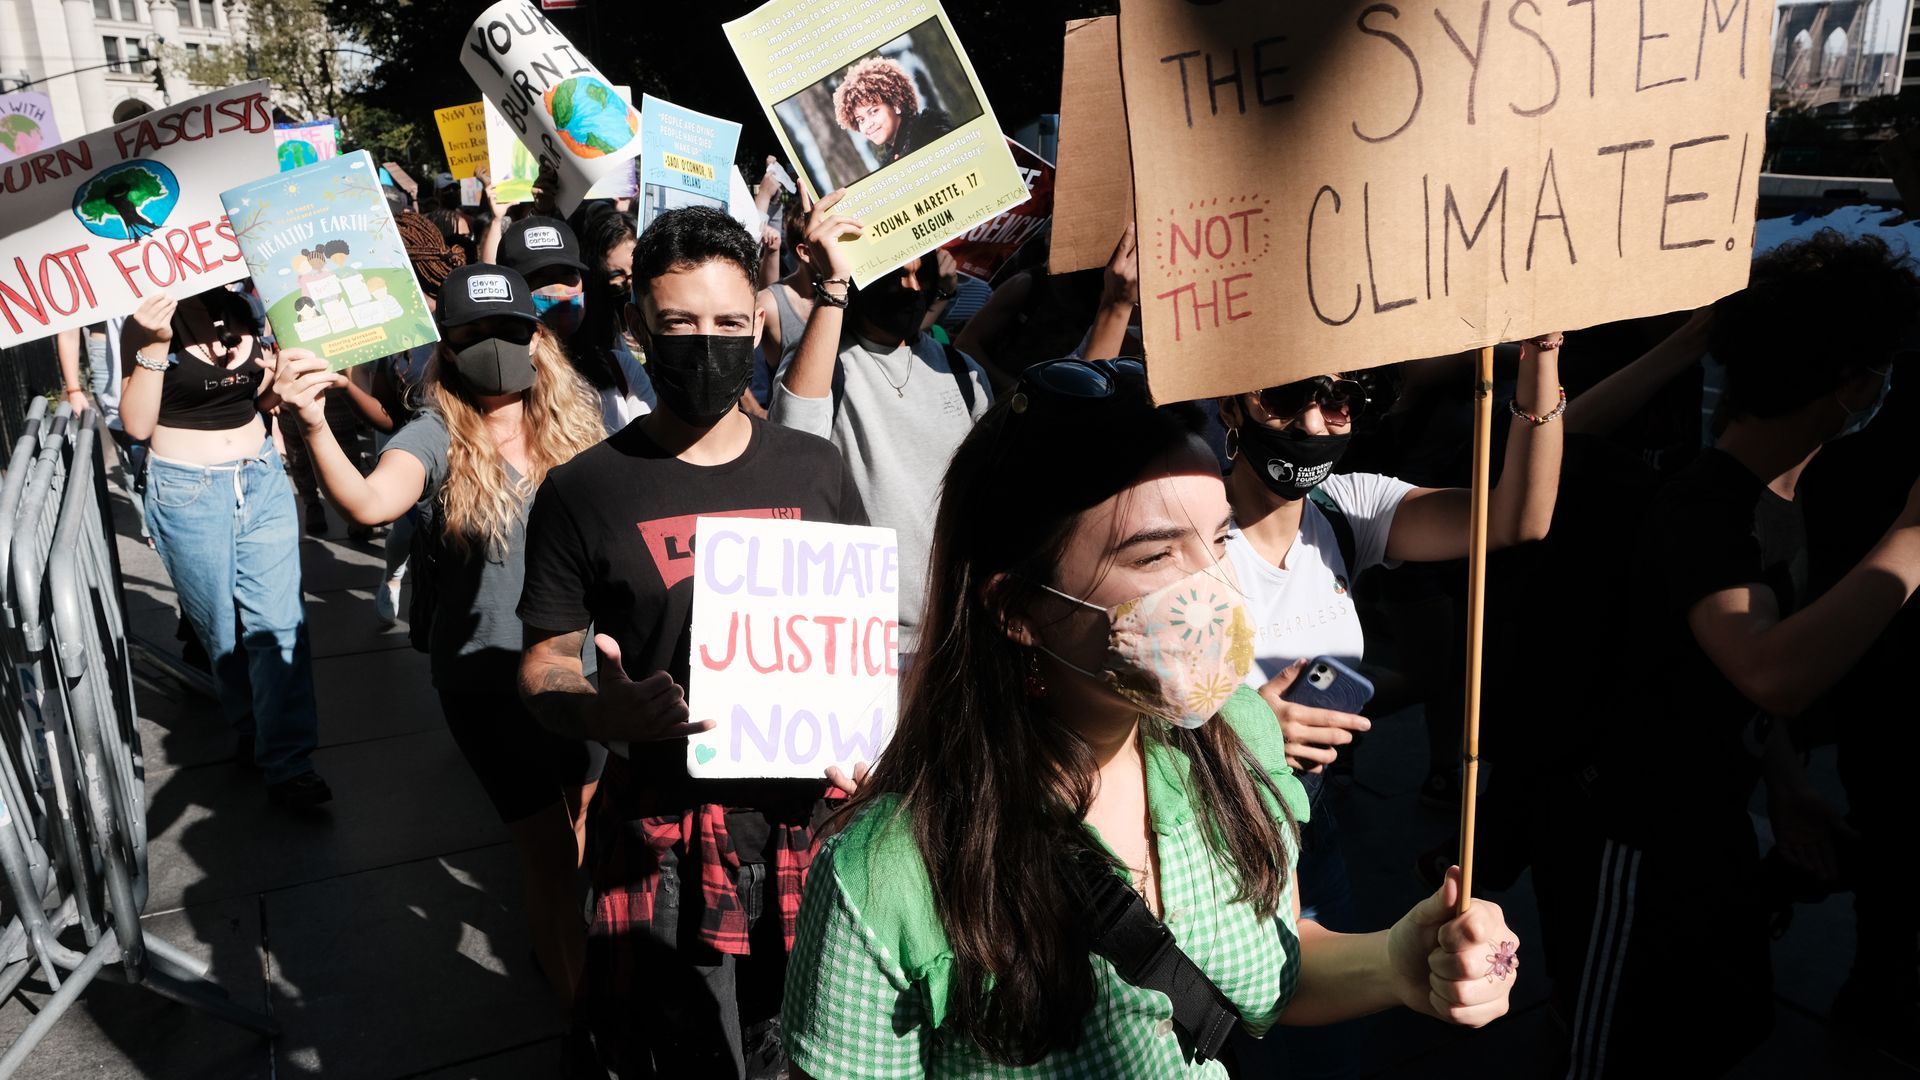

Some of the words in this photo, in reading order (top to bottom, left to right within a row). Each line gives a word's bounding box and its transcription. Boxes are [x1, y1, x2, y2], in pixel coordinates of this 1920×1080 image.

[751, 25, 770, 38] want
[771, 17, 781, 27] to
[783, 9, 797, 22] say
[767, 17, 809, 46] impossible
[809, 12, 820, 22] to
[820, 1, 840, 18] keep
[768, 34, 810, 63] permanent
[812, 16, 841, 40] growth
[796, 49, 816, 65] They
[816, 40, 829, 53] are
[831, 19, 863, 45] stealing
[864, 9, 885, 29] what
[768, 76, 797, 95] belong
[798, 68, 808, 79] to
[832, 47, 846, 61] our
[847, 28, 881, 52] common
[882, 14, 911, 37] future,
[911, 4, 928, 19] and
[1351, 0, 1750, 144] SYSTEM
[1160, 35, 1294, 129] THE
[9, 101, 46, 121] WITH
[113, 92, 272, 160] FASCISTS
[681, 174, 701, 190] IRELAND
[853, 190, 867, 202] are
[868, 171, 899, 195] missing
[907, 155, 934, 176] unique
[934, 127, 982, 159] opportunity
[874, 197, 888, 209] the
[889, 183, 914, 201] battle
[915, 173, 930, 188] and
[931, 162, 953, 178] make
[914, 183, 965, 217] MARETTE,
[966, 172, 979, 189] 17
[257, 221, 315, 260] HEALTHY
[320, 214, 368, 233] EARTH
[528, 230, 550, 239] clever
[529, 236, 556, 245] carbon
[855, 257, 888, 277] STILL
[891, 236, 933, 262] WAITING
[933, 226, 955, 242] FOR
[996, 187, 1027, 208] ACTION
[912, 209, 955, 240] BELGIUM
[1167, 207, 1264, 267] NOT
[1306, 132, 1749, 326] CLIMATE!
[0, 244, 98, 334] NOT
[472, 279, 498, 288] clever
[473, 286, 505, 295] carbon
[1157, 273, 1254, 341] THE
[704, 530, 898, 598] CLIMATE
[699, 611, 899, 677] JUSTICE
[1258, 602, 1348, 642] FEARLESS
[730, 703, 884, 765] NOW
